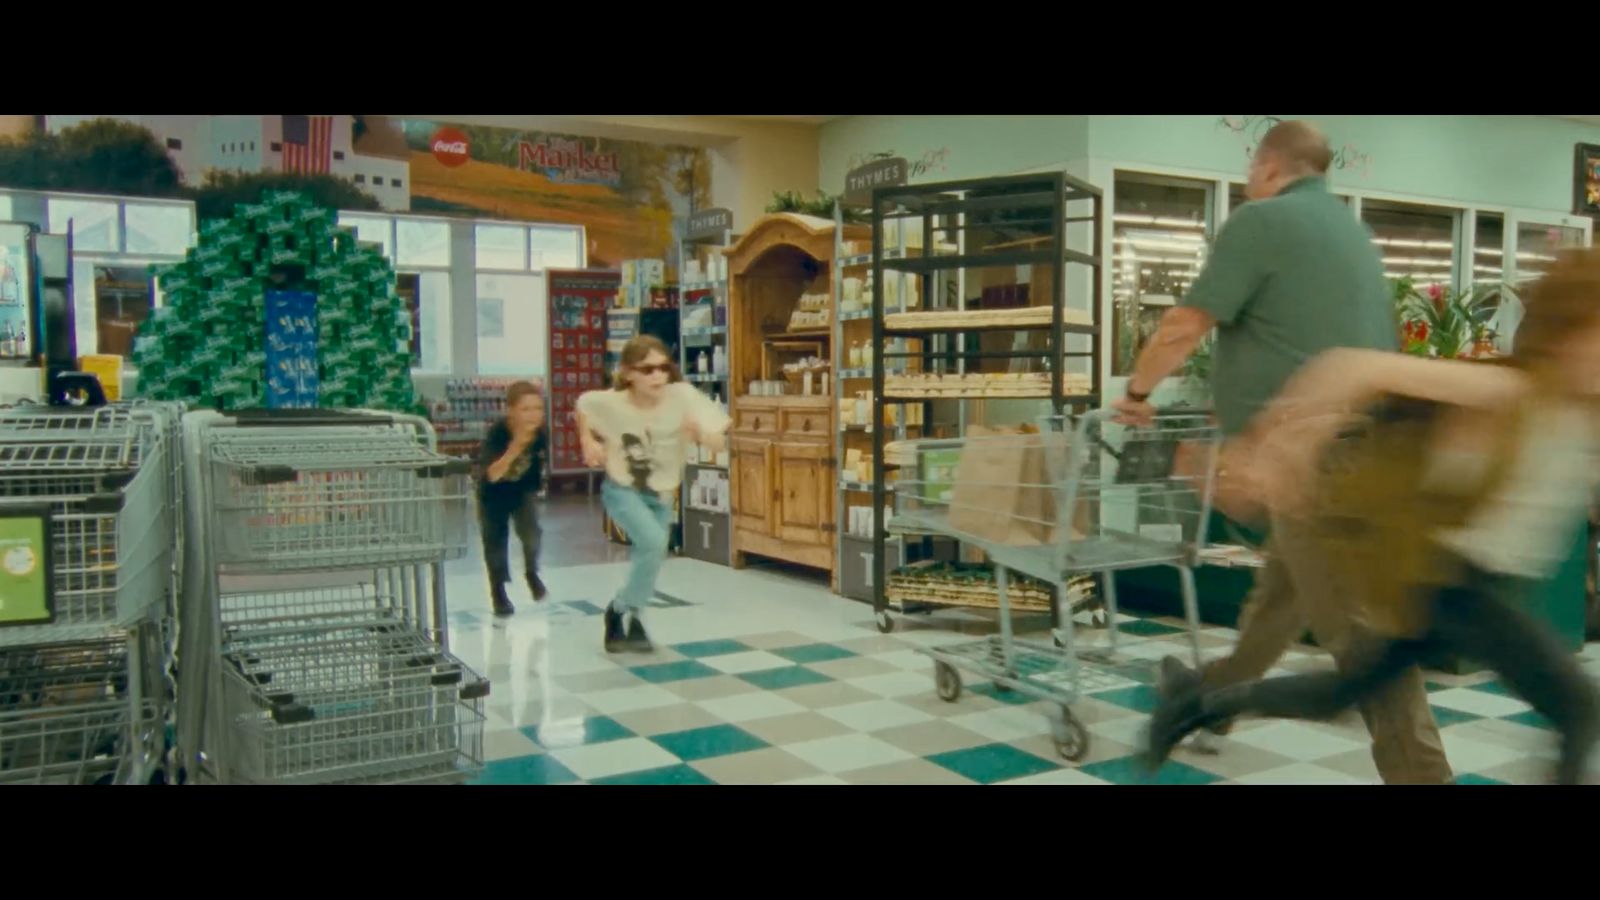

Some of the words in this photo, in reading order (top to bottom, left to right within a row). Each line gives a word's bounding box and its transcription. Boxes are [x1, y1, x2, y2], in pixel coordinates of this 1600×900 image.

[519, 142, 619, 171] Market
[850, 165, 899, 190] THYMES
[691, 213, 726, 231] THYMES
[699, 522, 713, 549] T
